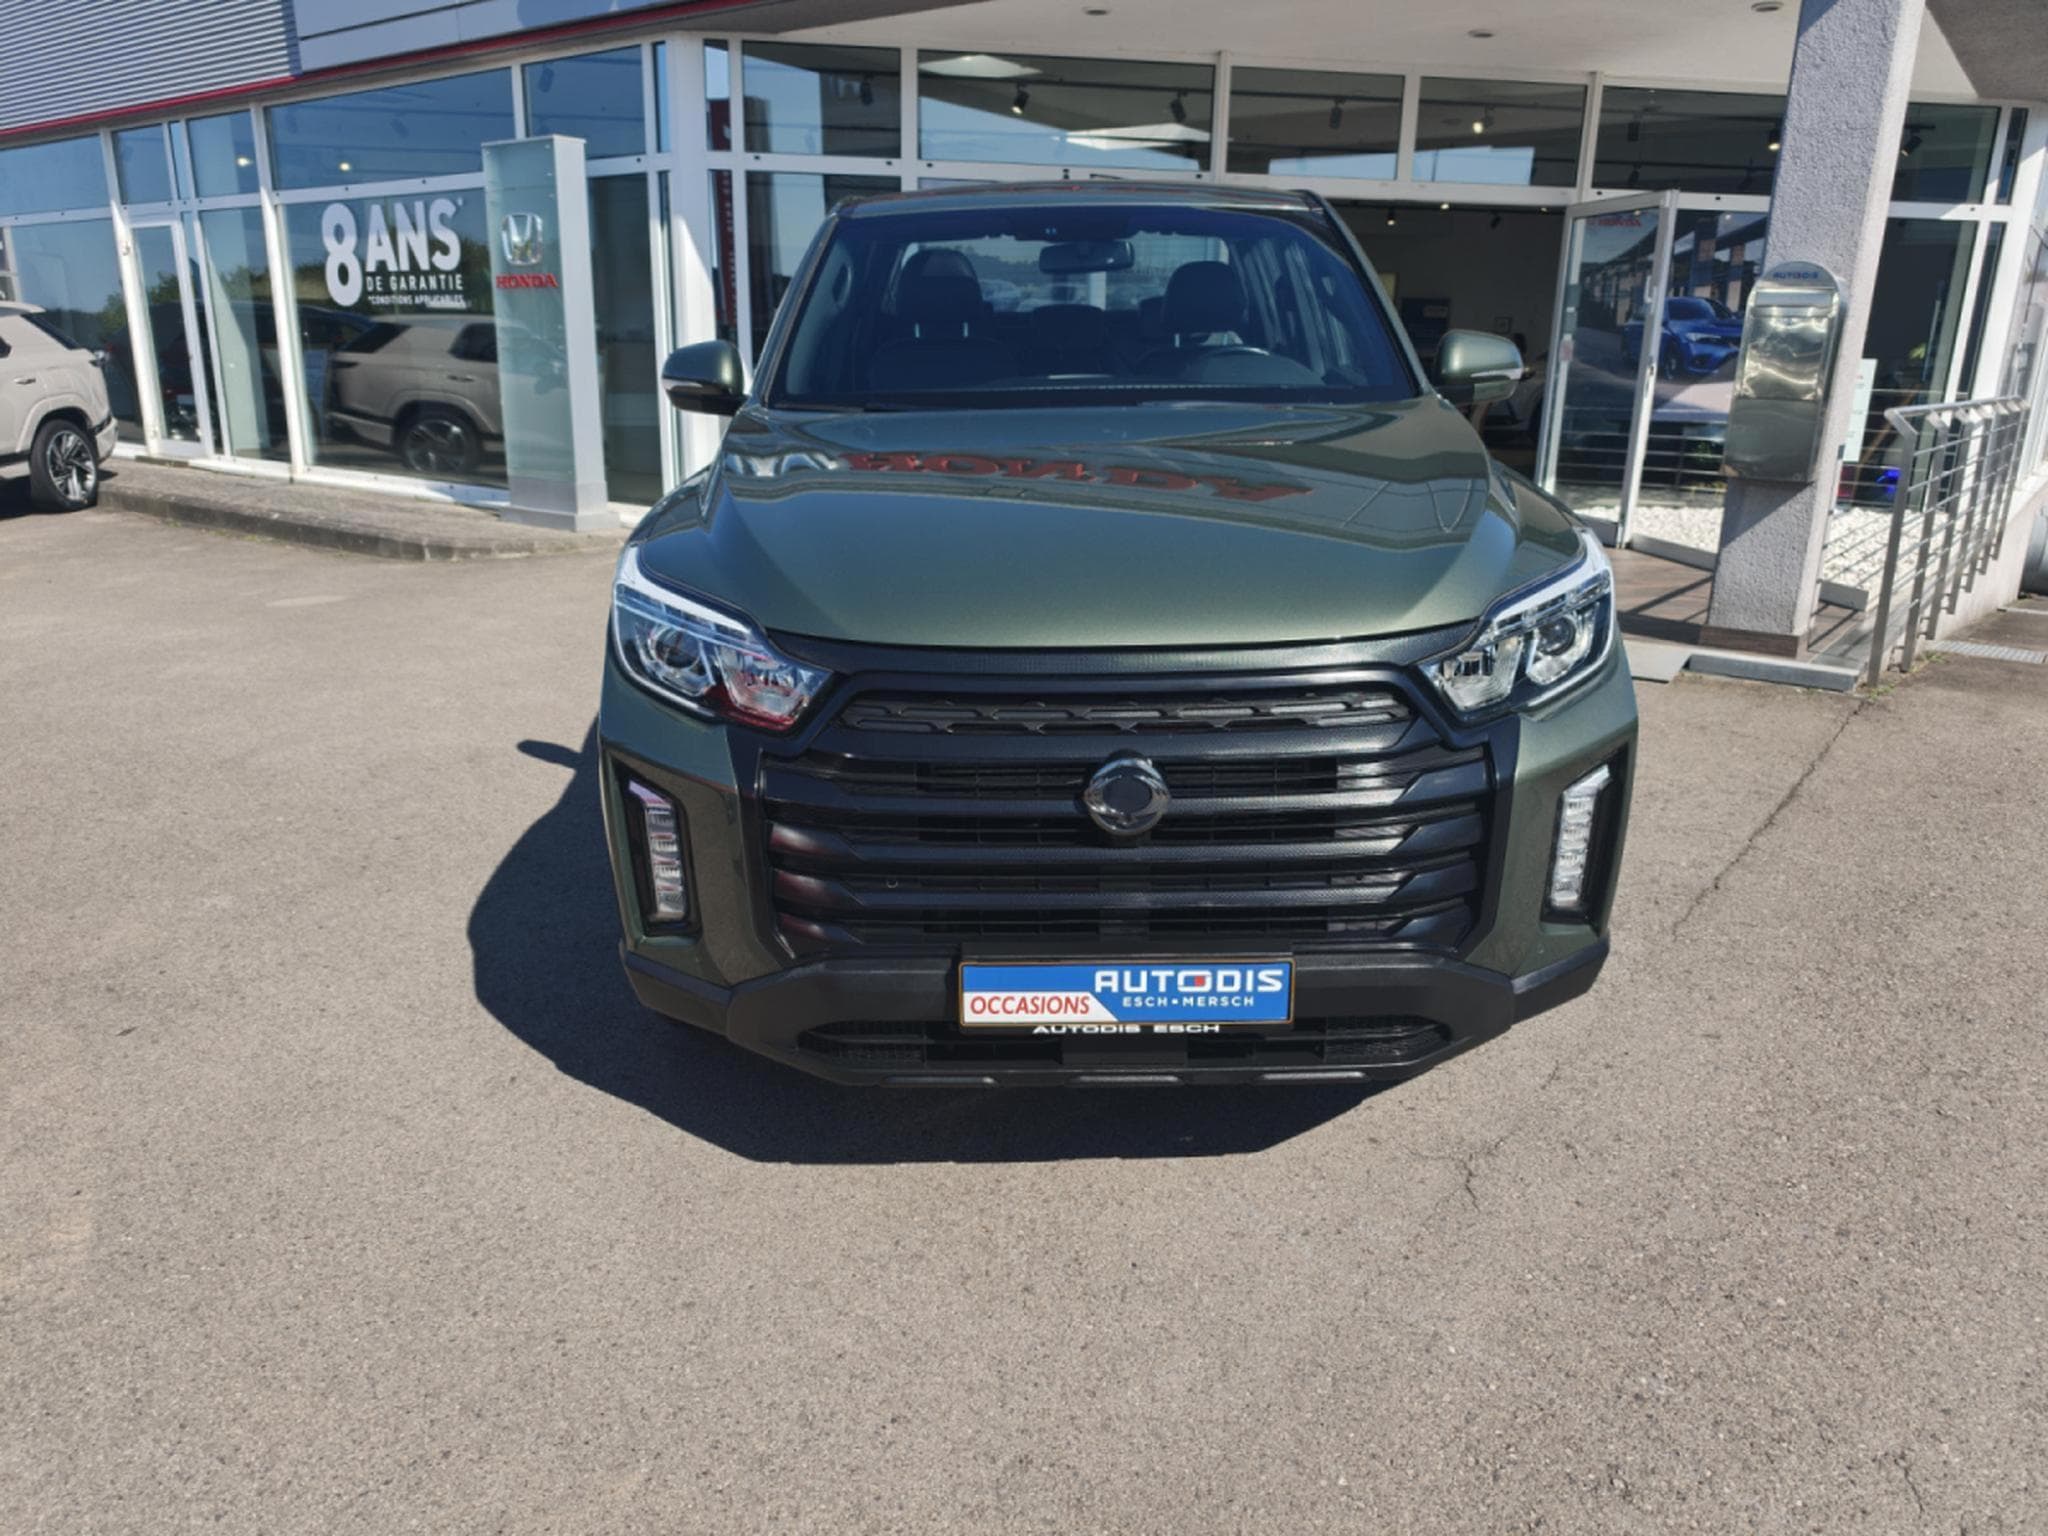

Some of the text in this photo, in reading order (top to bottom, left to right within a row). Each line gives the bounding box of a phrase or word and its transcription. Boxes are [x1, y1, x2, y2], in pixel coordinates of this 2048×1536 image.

[322, 202, 363, 307] 8
[366, 273, 463, 292] DE GARANTIE
[496, 272, 559, 289] HONDA
[1094, 969, 1284, 993] AUTODIS
[969, 995, 1091, 1016] OCCASIONS
[1032, 1023, 1220, 1034] AUTODIS ESCH
